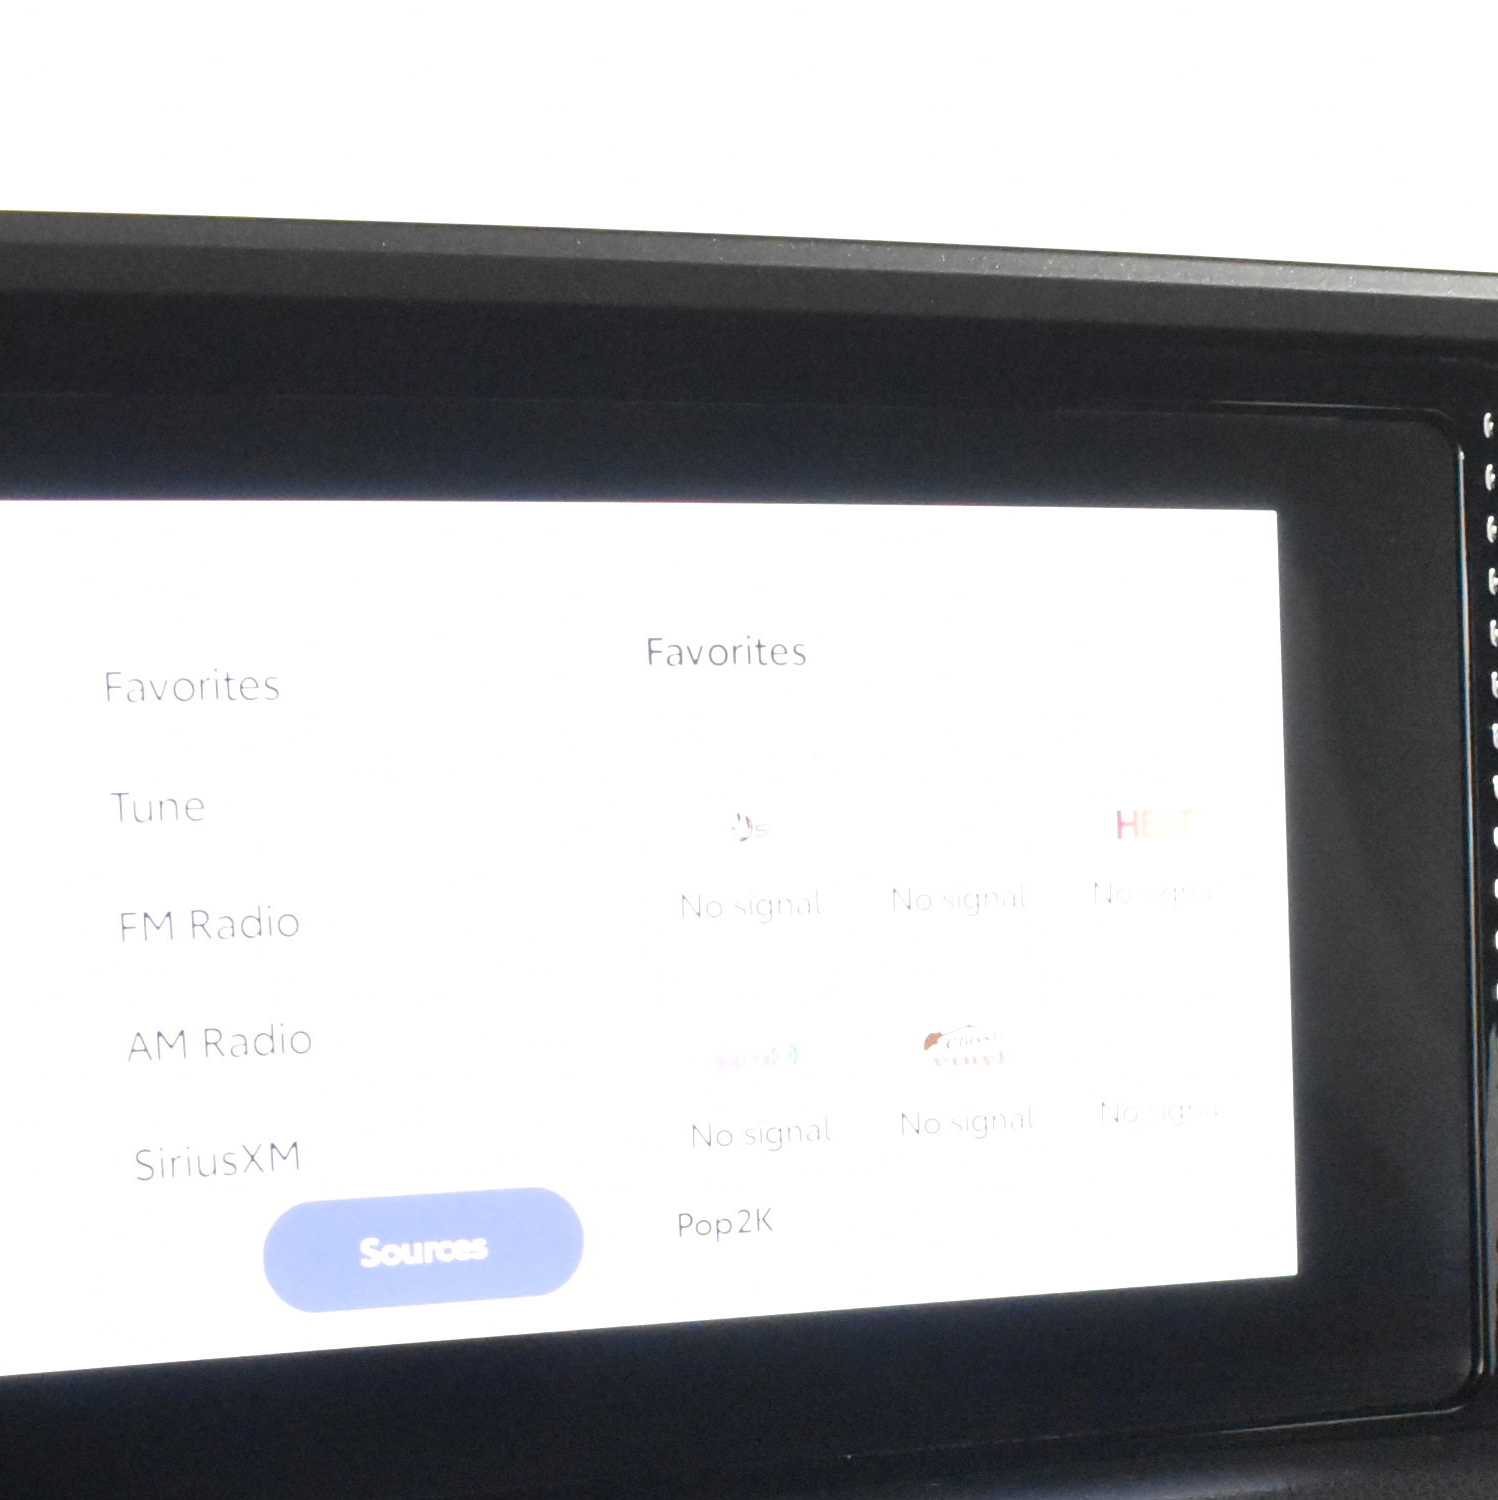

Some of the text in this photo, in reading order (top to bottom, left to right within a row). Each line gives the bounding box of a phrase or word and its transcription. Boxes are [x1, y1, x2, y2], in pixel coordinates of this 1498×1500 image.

[648, 635, 806, 666] Favorites
[104, 668, 280, 703] Favorites
[110, 792, 204, 823] Tune
[682, 890, 821, 923] No signal
[893, 888, 931, 910] No
[121, 906, 299, 942] FM Radio
[128, 1023, 311, 1061] AM Radio
[692, 1119, 830, 1151] No signal
[902, 1106, 1033, 1139] No signal
[136, 1141, 299, 1181] SiriusXM
[678, 1208, 773, 1242] Pop2K
[361, 1238, 487, 1267] Sources
